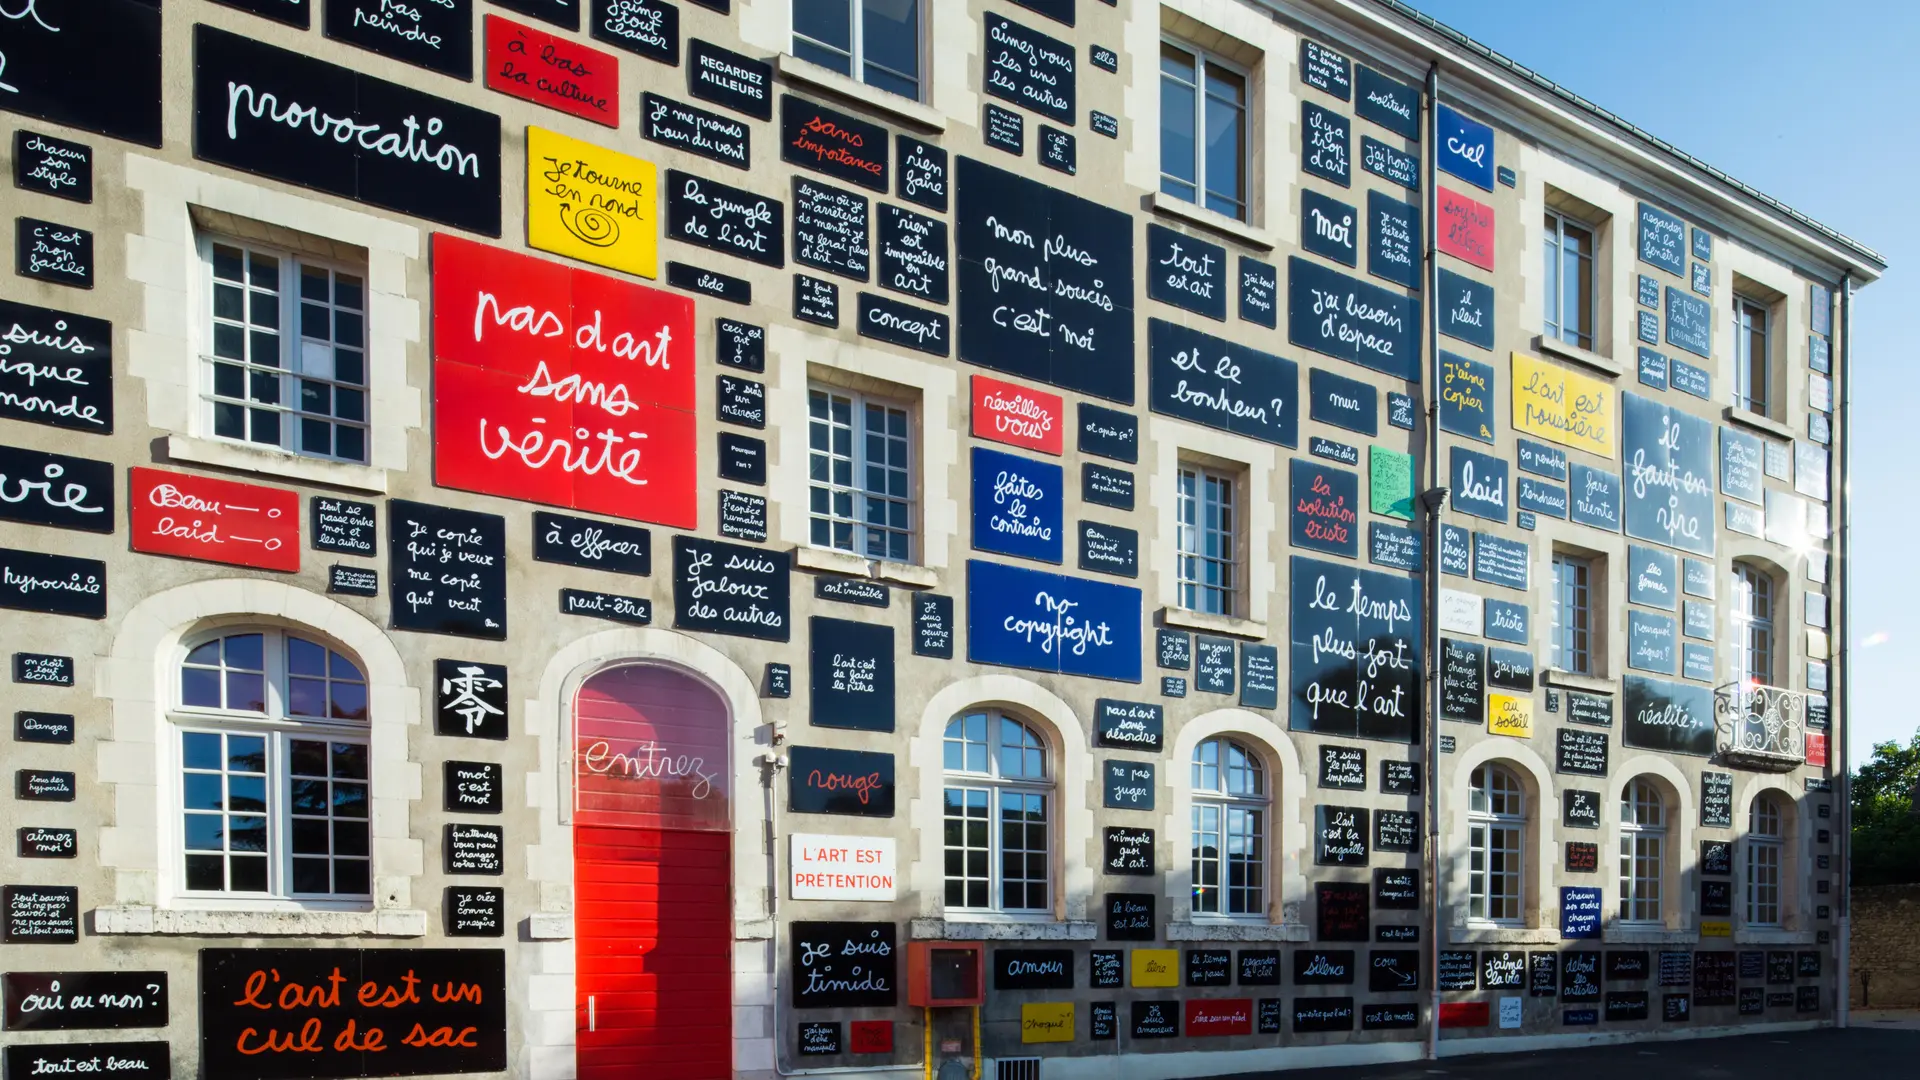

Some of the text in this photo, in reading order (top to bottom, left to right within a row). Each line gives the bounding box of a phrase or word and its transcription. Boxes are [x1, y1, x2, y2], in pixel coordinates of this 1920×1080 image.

[353, 7, 442, 49] peindre
[540, 44, 593, 77] bas
[991, 22, 1072, 73] aimez vous
[700, 55, 763, 85] REGARDEZ
[992, 52, 1022, 73] les
[537, 78, 607, 111] culture
[700, 70, 763, 99] AILLEURS
[1023, 85, 1068, 110] autres
[1367, 90, 1410, 120] solitude
[227, 81, 479, 178] provocation
[672, 109, 743, 138] me prends
[804, 116, 863, 147] sans
[26, 137, 86, 162] chacun
[715, 140, 745, 161] vent
[793, 129, 882, 174] importance
[906, 146, 942, 176] rien
[1447, 128, 1484, 169] ciel
[28, 166, 76, 188] style
[575, 160, 642, 197] tourne
[545, 183, 644, 221] en rond
[683, 180, 772, 228] la jungle
[685, 221, 708, 238] de
[901, 235, 923, 250] est
[986, 215, 1097, 267] mon plus
[884, 242, 945, 270] impossible
[1160, 243, 1215, 277] tout
[895, 273, 932, 294] art
[984, 257, 1113, 312] grand soucis
[474, 290, 564, 342] pas
[869, 308, 940, 343] concept
[1345, 293, 1402, 333] besoin
[1451, 308, 1482, 327] pleut
[1, 320, 94, 351] suis
[992, 305, 1095, 351] c'est moi
[1171, 348, 1206, 374] et
[517, 360, 639, 417] sans
[1329, 393, 1360, 411] mur
[995, 415, 1043, 439] vous
[1658, 415, 1680, 452] il
[480, 417, 648, 485] vérité
[1311, 475, 1331, 496] la
[1460, 460, 1504, 507] laid
[1631, 448, 1709, 499] faut en
[994, 470, 1044, 504] faites
[319, 500, 341, 513] tout
[320, 513, 348, 524] passe
[1007, 499, 1027, 519] le
[1297, 495, 1356, 523] solution
[1656, 495, 1702, 541] rire
[437, 527, 482, 547] copie
[545, 521, 642, 560] à effacer
[990, 515, 1052, 541] contraire
[1444, 528, 1460, 542] en
[337, 538, 371, 550] autres
[407, 541, 436, 562] qui
[724, 554, 775, 574] suis
[1443, 557, 1467, 571] mots
[4, 566, 100, 594] hypocrisie
[407, 568, 482, 592] me copie
[406, 590, 434, 614] qui
[568, 595, 647, 618] peut-être
[688, 603, 782, 627] des autres
[1309, 574, 1340, 611] le
[1346, 578, 1412, 634] temps
[1491, 609, 1524, 633] triste
[1004, 614, 1113, 656] copyright
[1312, 626, 1409, 679] plus fort
[833, 669, 847, 680] de
[1106, 705, 1127, 717] pas
[1306, 681, 1350, 720] que
[1503, 701, 1520, 712] au
[1118, 719, 1147, 732] sans
[1494, 714, 1529, 729] soleil
[1637, 703, 1690, 729] réalité
[1105, 727, 1157, 745] désordre
[585, 740, 717, 800] entrez
[1112, 767, 1151, 781] ne pas
[459, 793, 491, 805] moi
[807, 769, 882, 805] rouge
[26, 828, 73, 848] aimez
[35, 843, 62, 852] moi
[856, 849, 882, 864] EST
[795, 873, 892, 889] PRÉTENTION
[1125, 900, 1148, 913] beau
[841, 929, 892, 956] suis
[1007, 960, 1063, 976] amour
[1303, 954, 1344, 976] silence
[1487, 970, 1522, 985] la vie
[233, 967, 482, 1010] l'art est un
[801, 965, 890, 995] timide
[20, 980, 65, 1013] oui
[236, 1017, 477, 1055] cul de sac
[31, 1056, 149, 1075] tout beau
